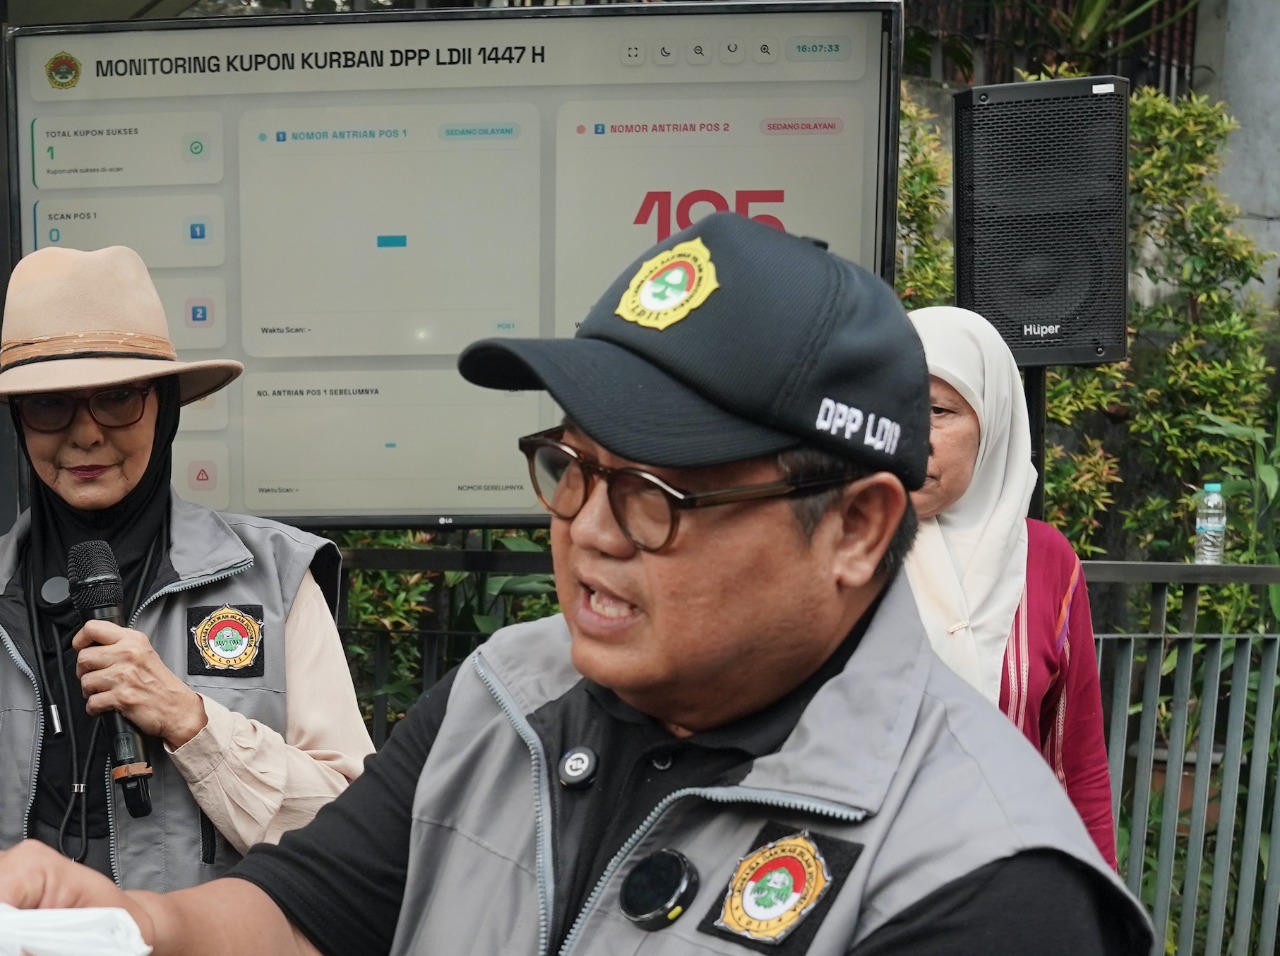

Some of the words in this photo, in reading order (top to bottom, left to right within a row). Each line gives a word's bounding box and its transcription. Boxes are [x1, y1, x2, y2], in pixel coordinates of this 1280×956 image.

[796, 44, 840, 53] 16:07:33
[96, 55, 220, 77] MONITORING
[226, 53, 295, 72] KUPON
[301, 50, 384, 70] KURBAN
[389, 49, 430, 67] DPP
[436, 47, 472, 66] LDII
[477, 46, 526, 65] 1447
[532, 45, 545, 63] H
[610, 124, 648, 133] NOMOR
[651, 123, 696, 132] ANTRIAN
[699, 123, 720, 132] POS
[723, 123, 730, 132] 2
[800, 122, 836, 130] DILAYANI
[45, 131, 72, 139] TOTAL
[73, 129, 104, 137] KUPON
[105, 128, 139, 136] SUKSES
[291, 131, 328, 141] NOMOR
[332, 130, 376, 139] ANTRIAN
[379, 129, 399, 138] POS
[402, 129, 408, 137] 1
[46, 146, 54, 160] 1
[48, 213, 72, 221] SCAN
[73, 212, 91, 220] POS
[49, 228, 60, 242] 0
[1023, 323, 1061, 337] Hüper
[329, 388, 379, 396] SEBELUMNYA
[816, 397, 864, 440] DPP
